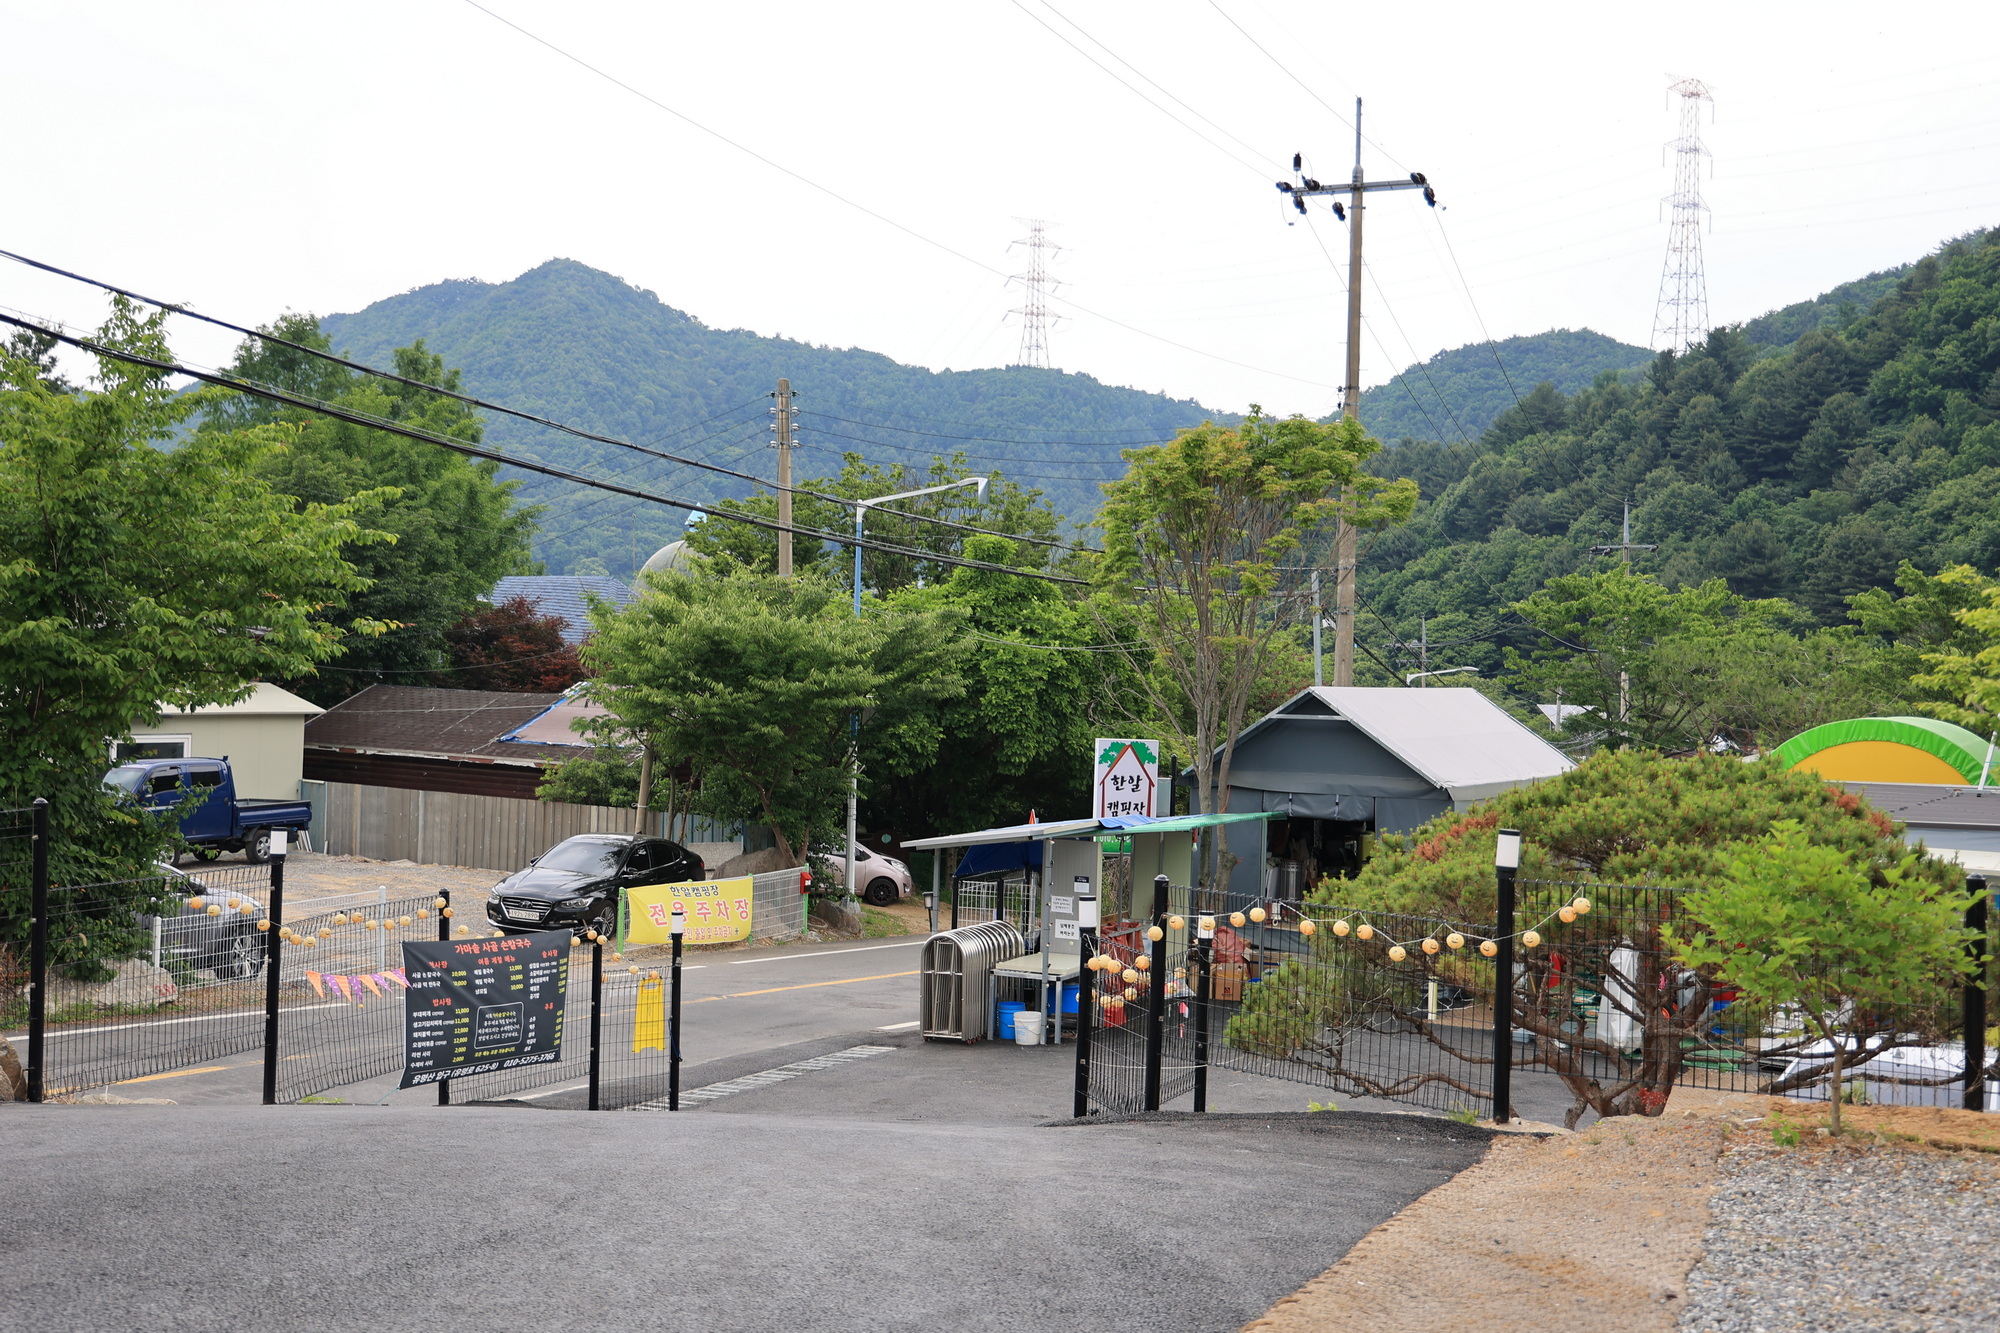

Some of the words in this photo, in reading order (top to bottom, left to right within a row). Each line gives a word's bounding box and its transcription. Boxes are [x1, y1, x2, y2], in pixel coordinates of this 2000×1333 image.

[1111, 775, 1143, 792] 한알
[669, 885, 719, 897] 한알캠핑장
[455, 942, 480, 954] 가마솥
[482, 941, 499, 952] 사골
[501, 938, 531, 950] 손칼국수
[412, 1071, 436, 1084] 유명산
[435, 1070, 451, 1080] 입구
[451, 1066, 475, 1078] (유명로
